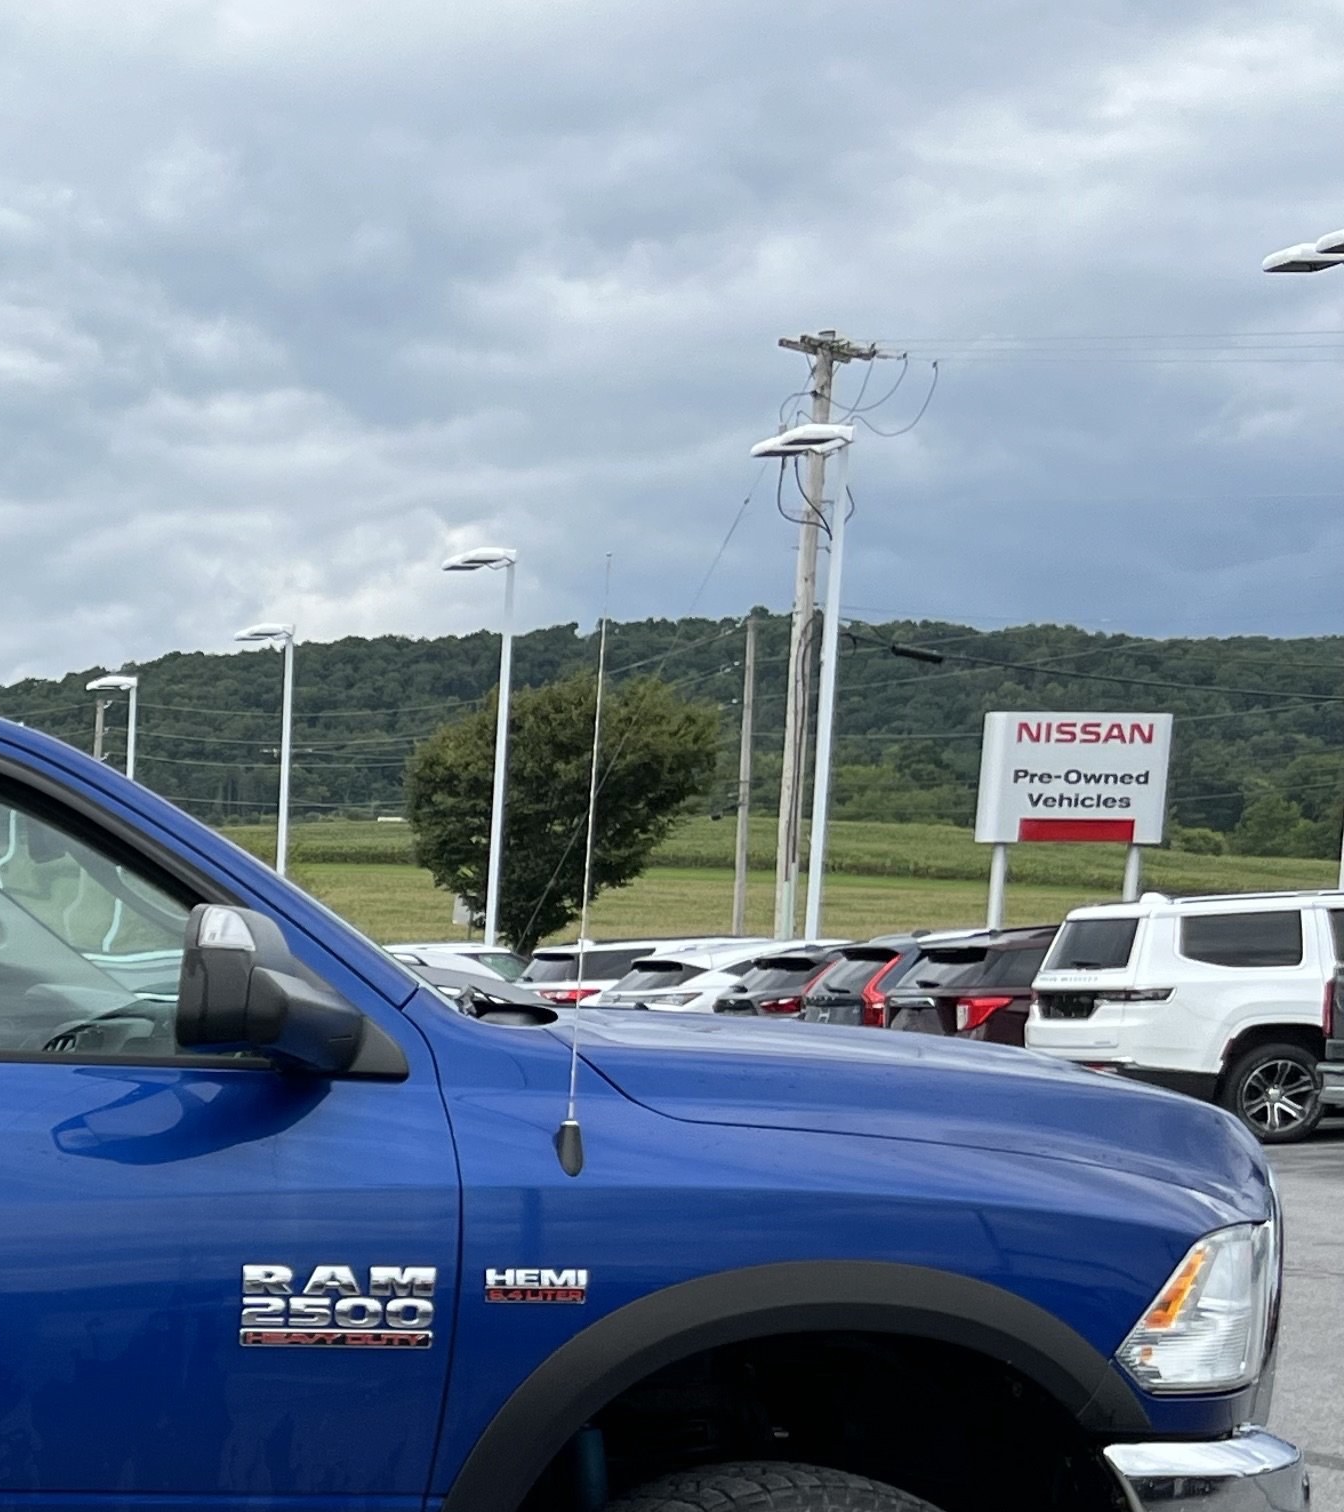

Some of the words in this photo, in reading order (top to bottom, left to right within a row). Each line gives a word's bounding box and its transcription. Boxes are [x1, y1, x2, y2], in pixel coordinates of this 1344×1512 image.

[1016, 721, 1154, 745] NISSAN
[1013, 768, 1150, 786] Pre-Owned
[1027, 793, 1132, 809] Vehicles
[241, 1263, 438, 1297] RAM
[485, 1268, 588, 1287] HEMI
[525, 1289, 583, 1302] LITER
[240, 1296, 435, 1329] 2500
[246, 1332, 341, 1346] HEAVY
[344, 1332, 430, 1347] DUTY
